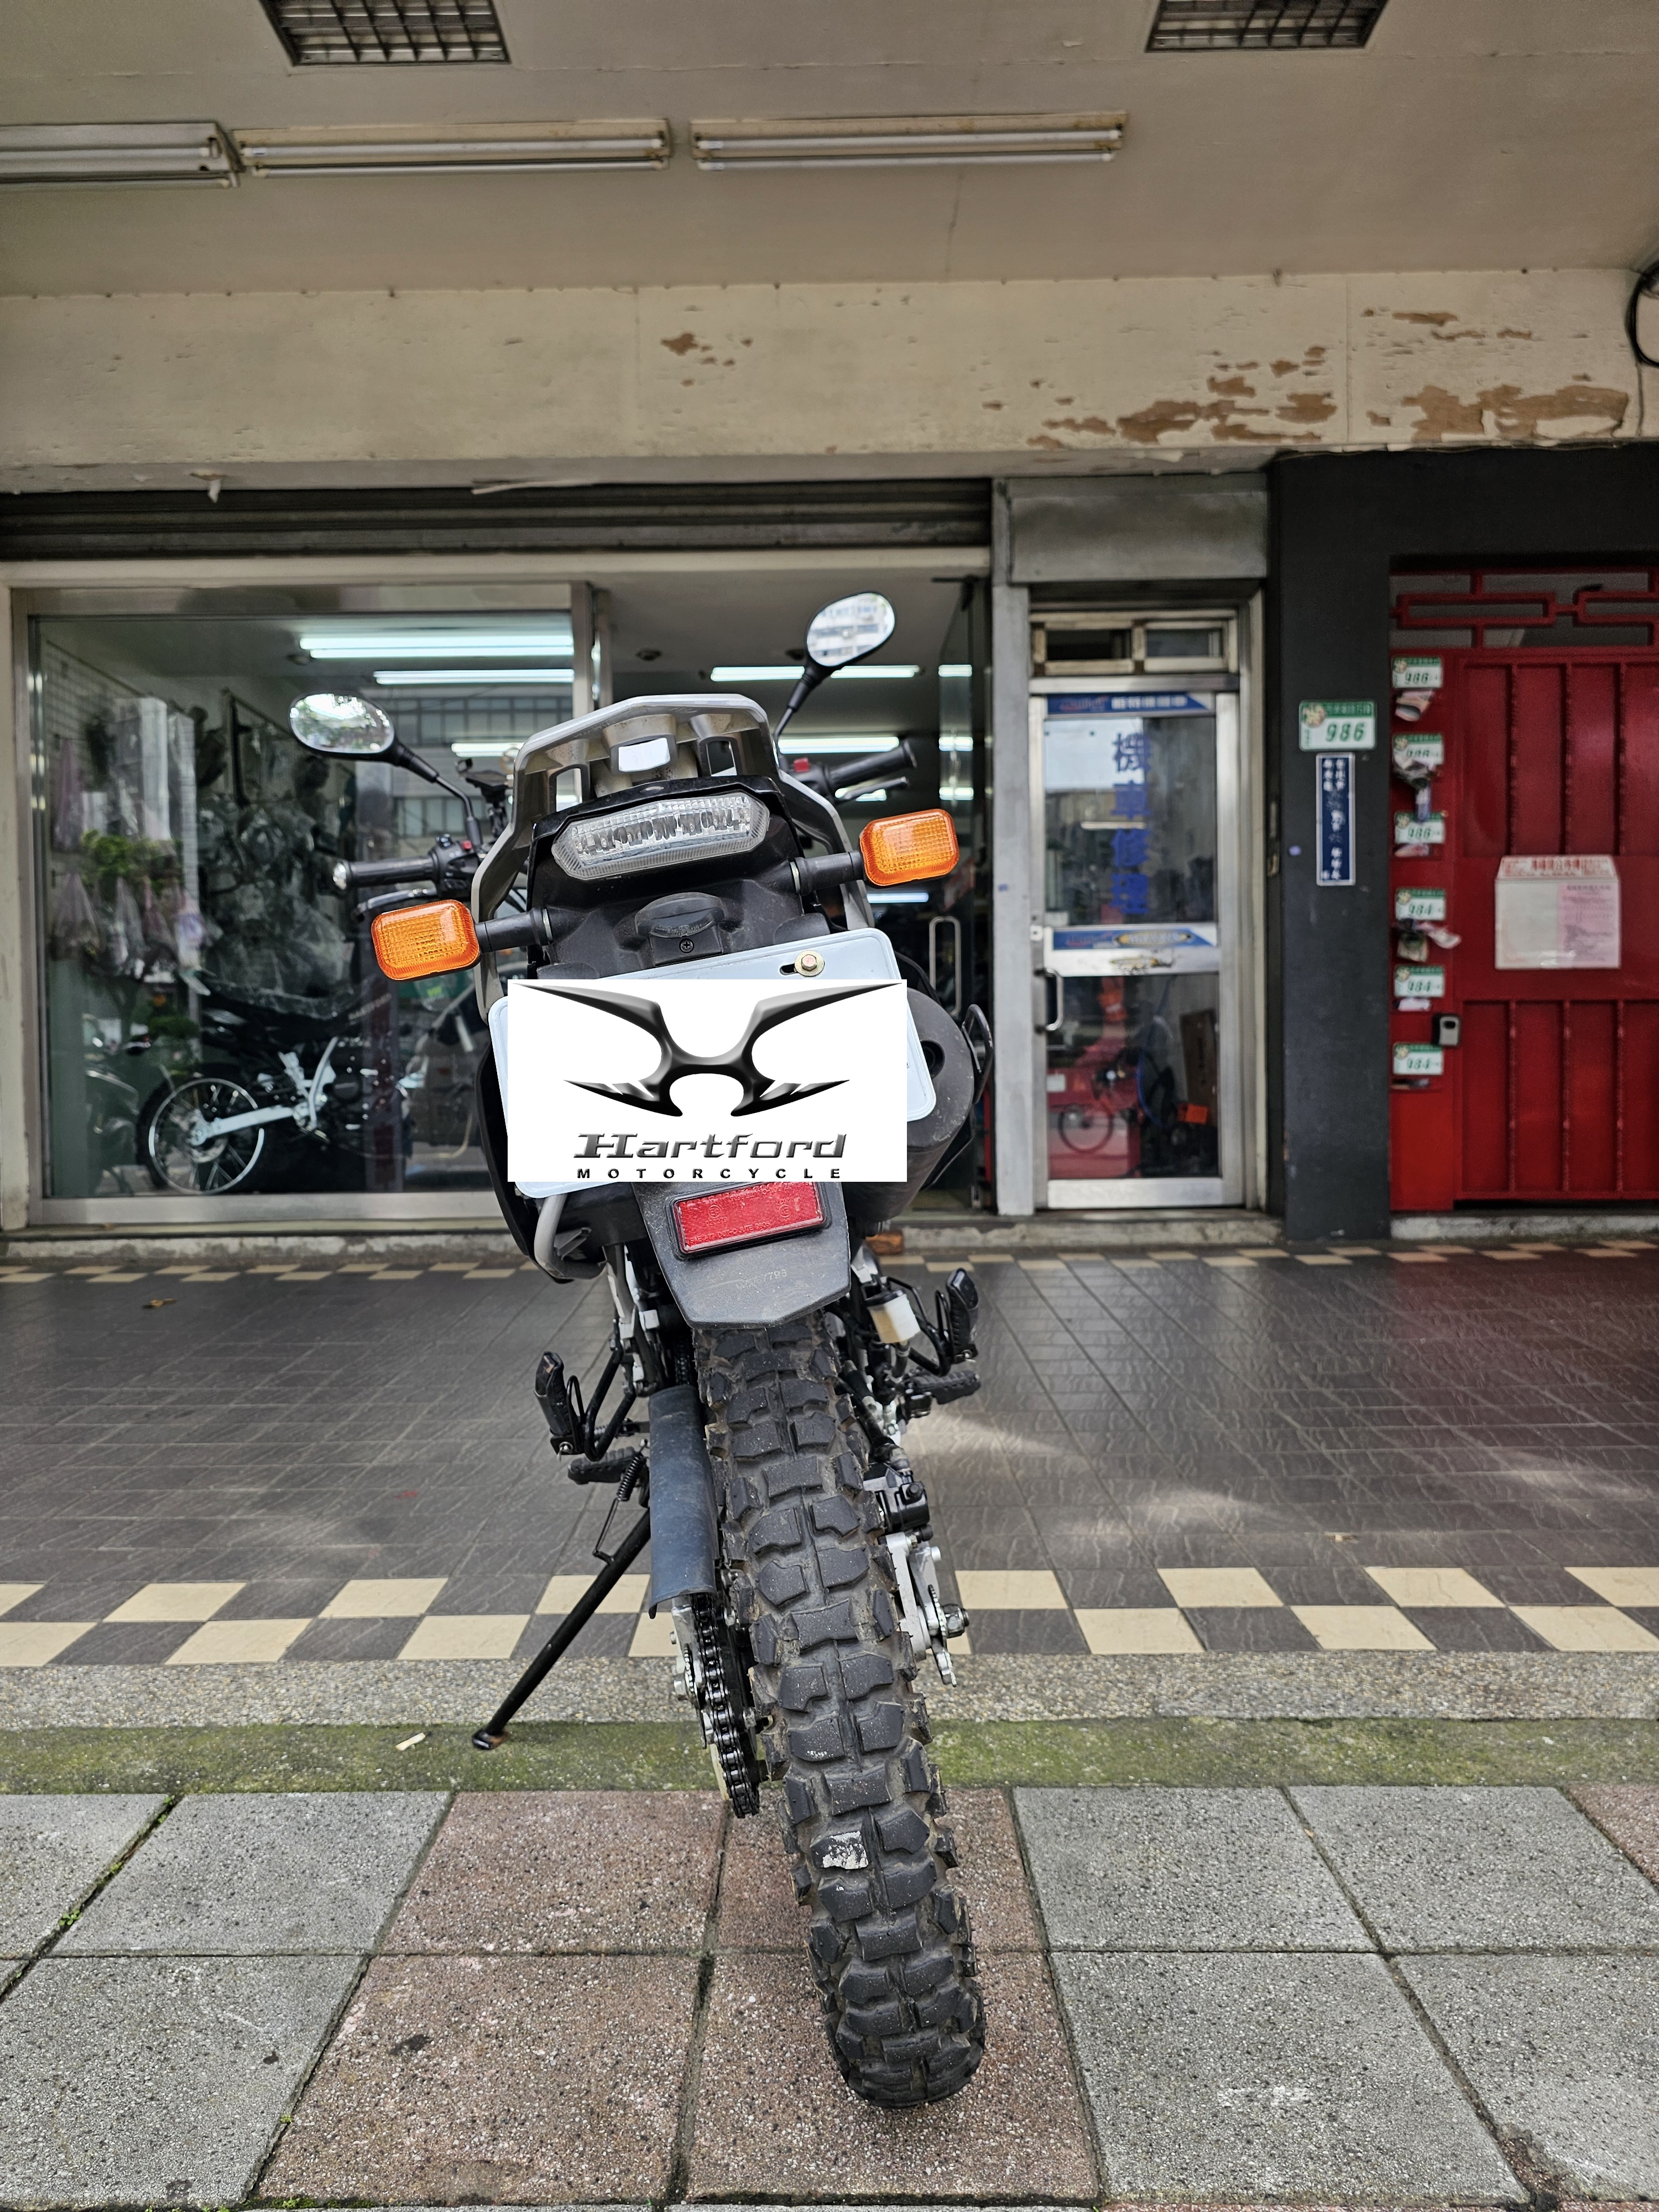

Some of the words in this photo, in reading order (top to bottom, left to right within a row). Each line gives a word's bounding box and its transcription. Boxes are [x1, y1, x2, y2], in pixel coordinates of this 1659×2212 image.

[1326, 722, 1365, 742] 986
[1110, 731, 1152, 916] 機車修理
